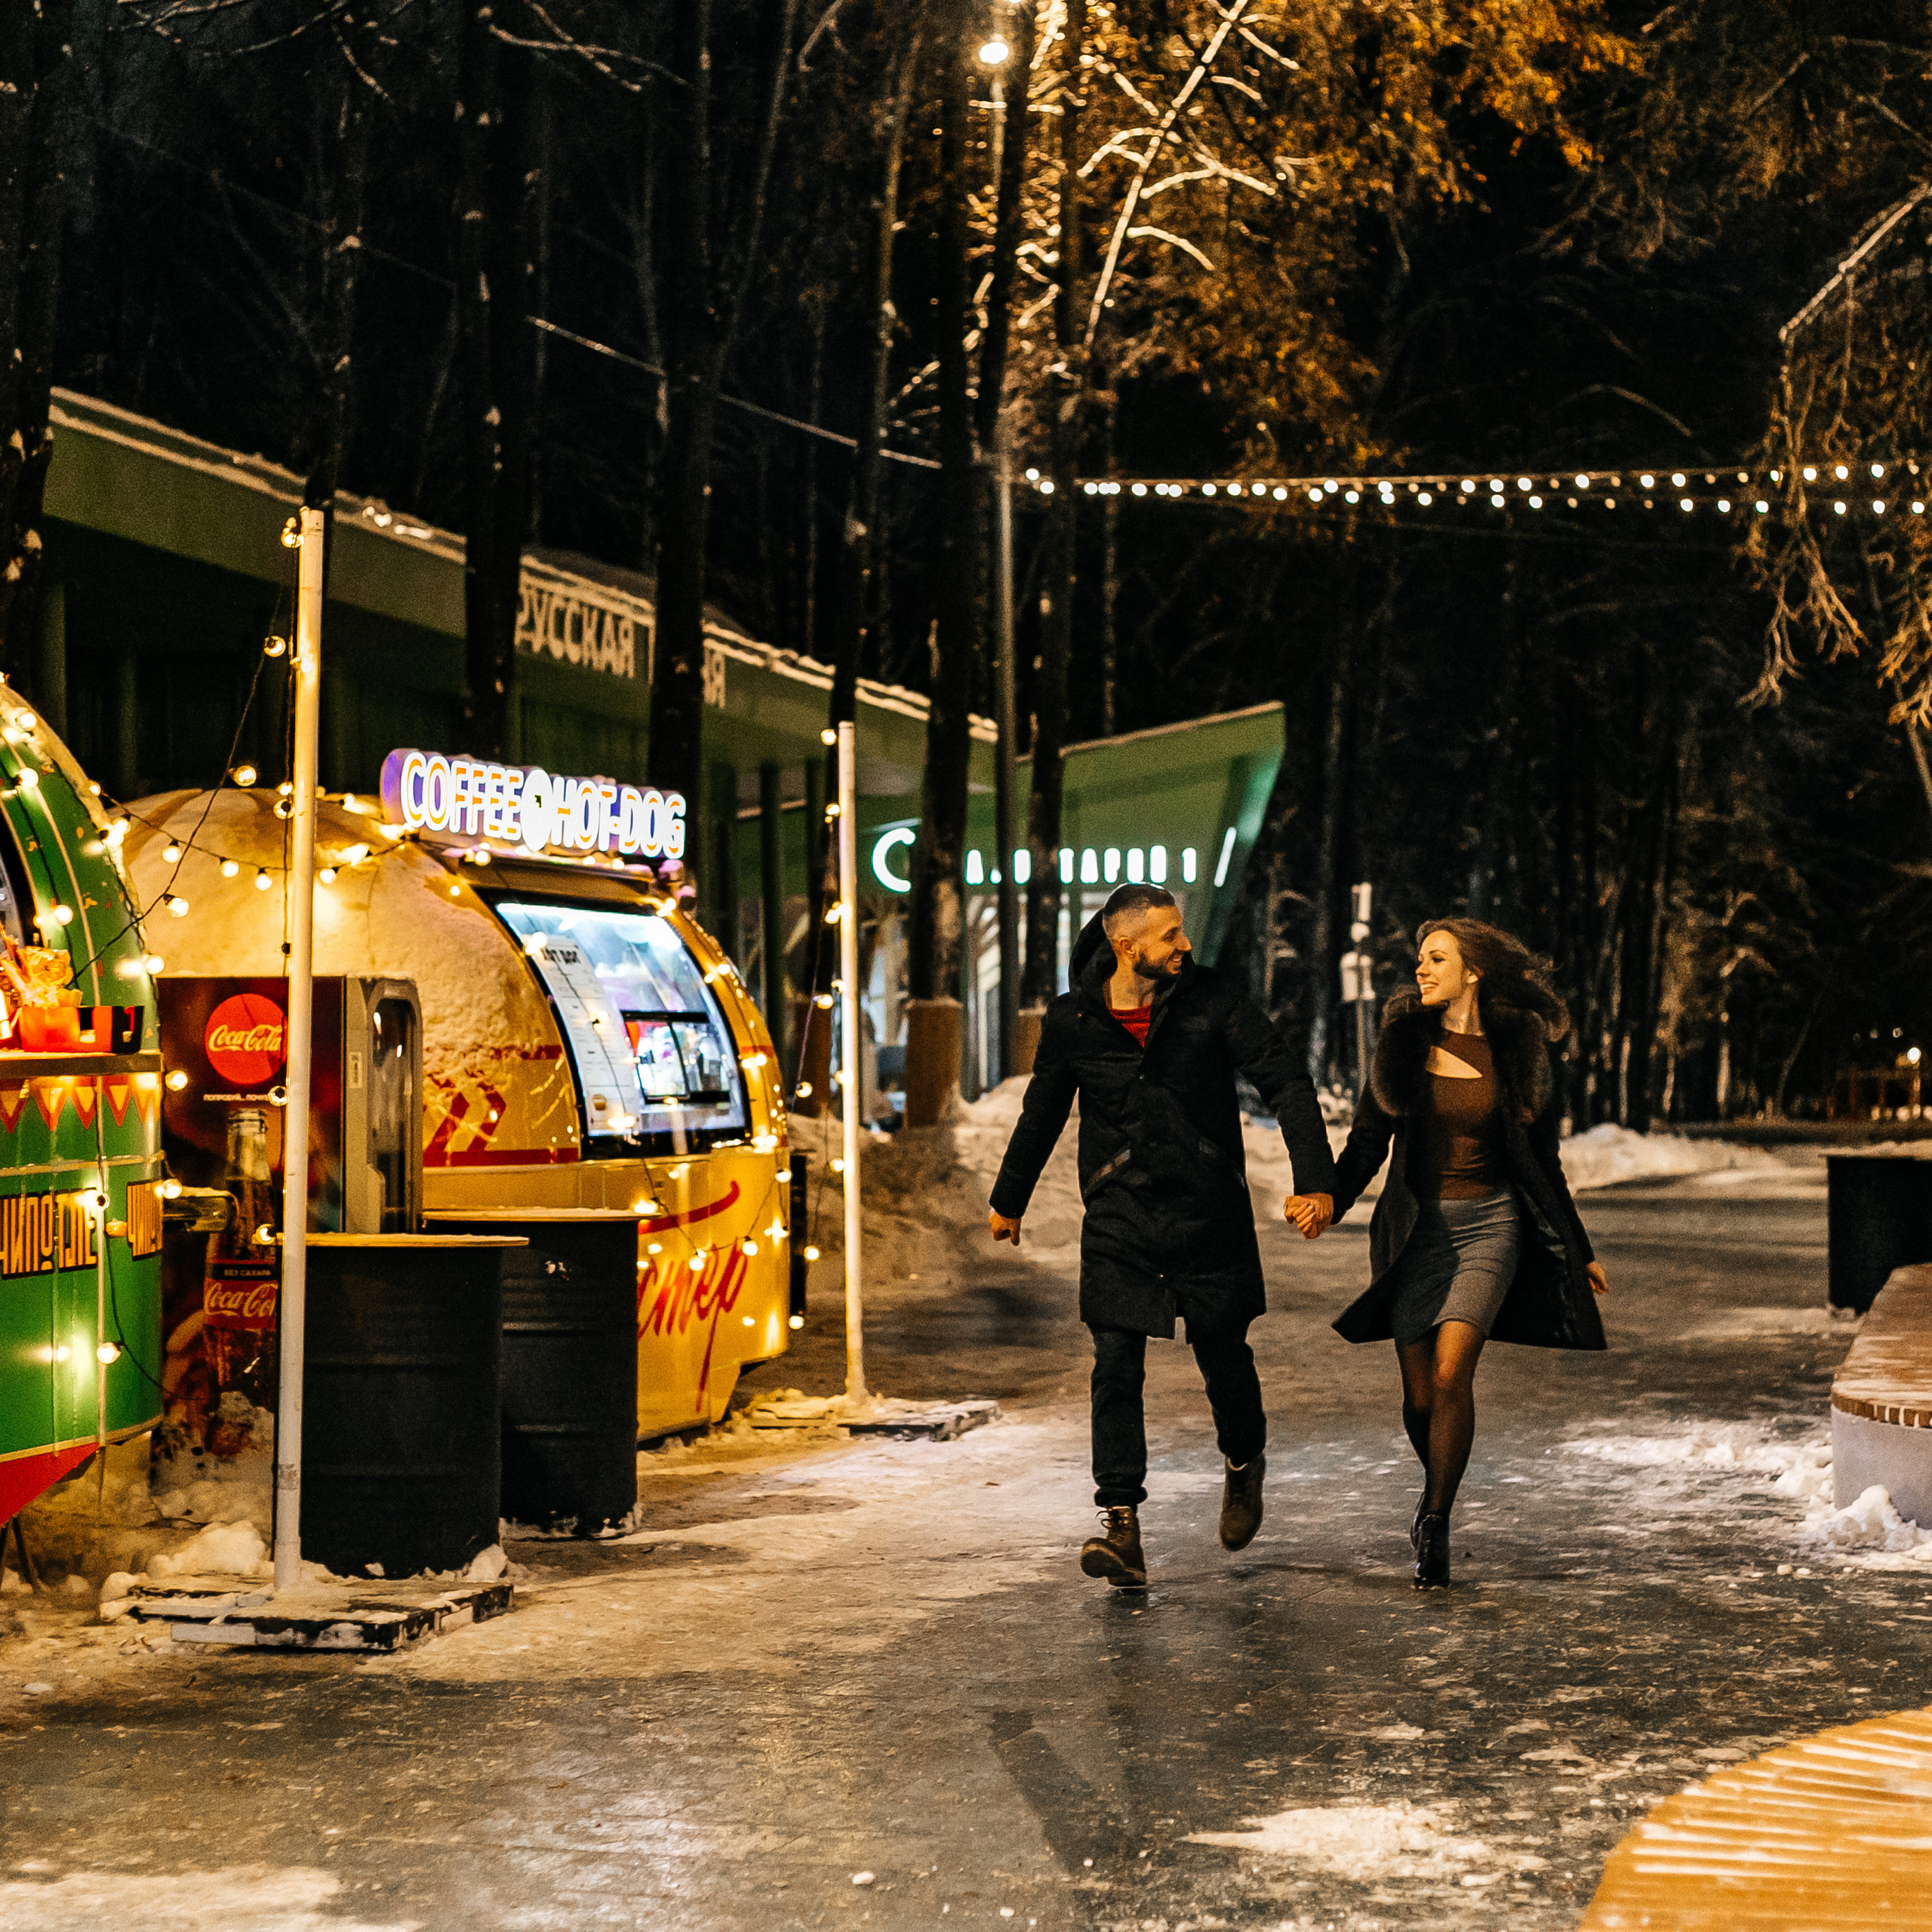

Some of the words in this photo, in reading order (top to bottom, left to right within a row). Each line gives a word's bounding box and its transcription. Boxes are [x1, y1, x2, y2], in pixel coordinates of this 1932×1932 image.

[401, 751, 525, 841] COFFEE
[550, 775, 686, 860] HOT-DOG
[208, 1024, 283, 1052] Coca-Cola
